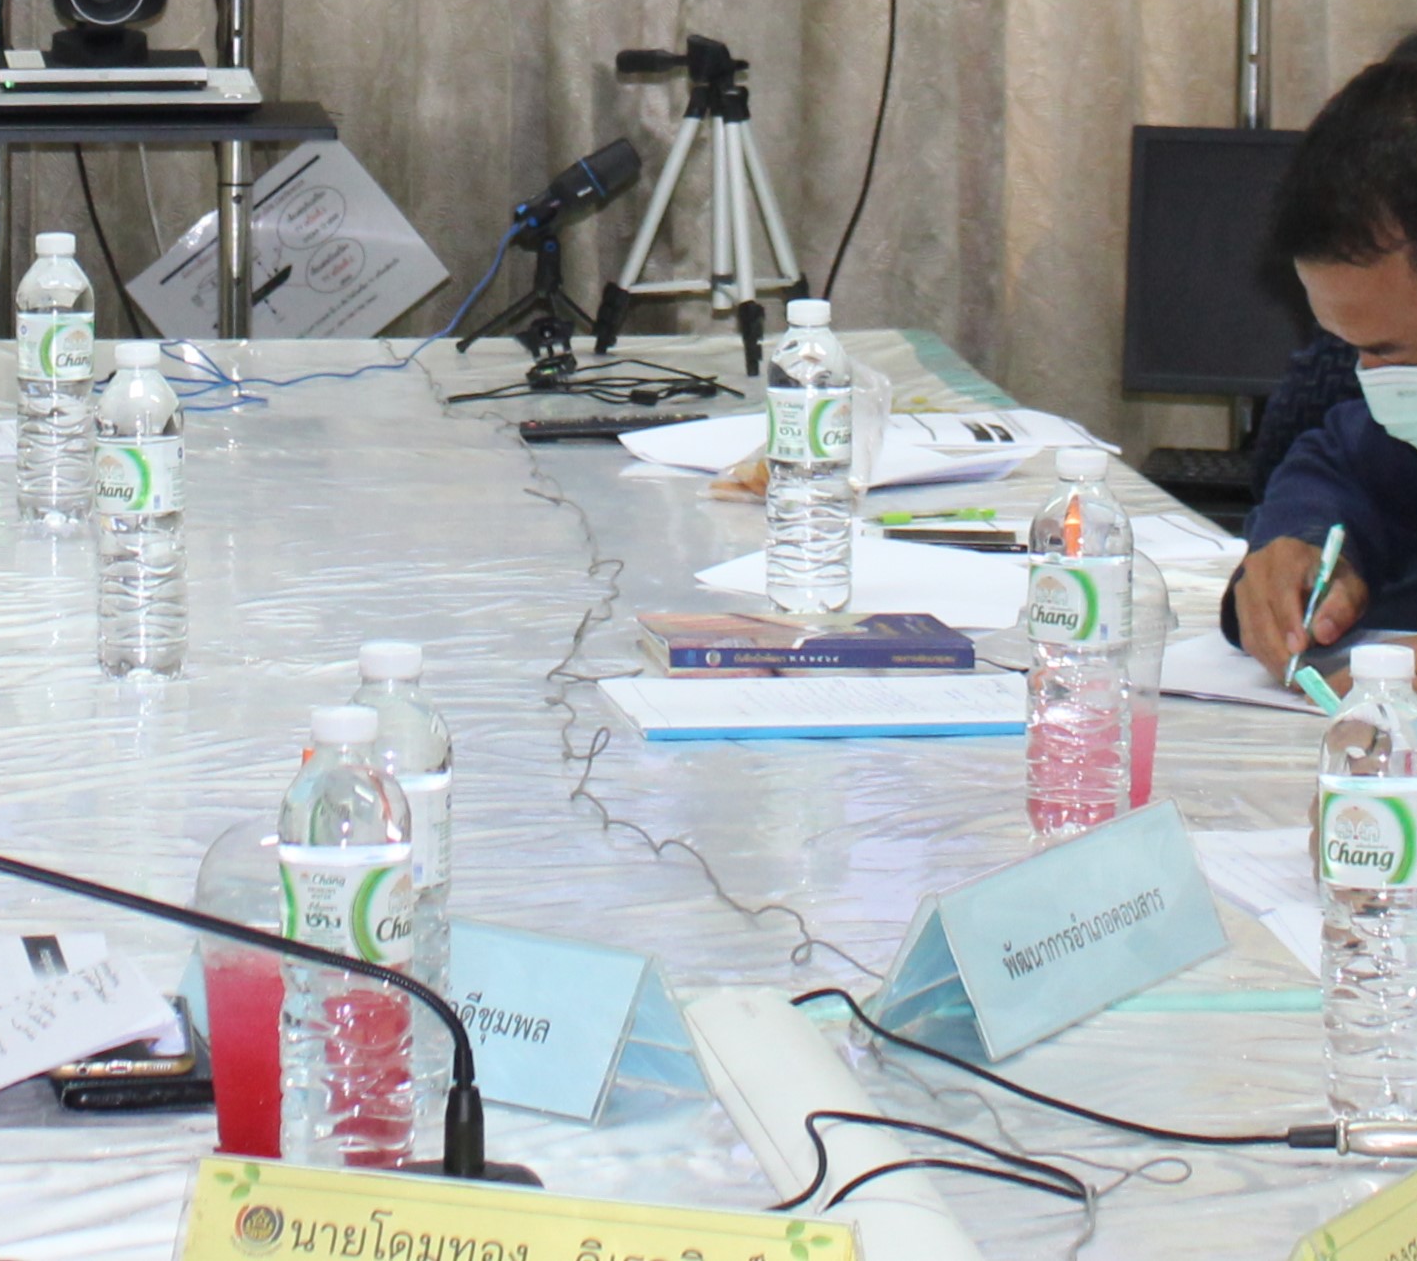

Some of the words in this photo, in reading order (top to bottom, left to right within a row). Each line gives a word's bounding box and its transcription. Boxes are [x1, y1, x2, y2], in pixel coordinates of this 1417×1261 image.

[1030, 602, 1080, 631] Chang
[1327, 839, 1396, 872] Chang
[1001, 886, 1165, 981] พัฒนาการอำเภอคอนสาร
